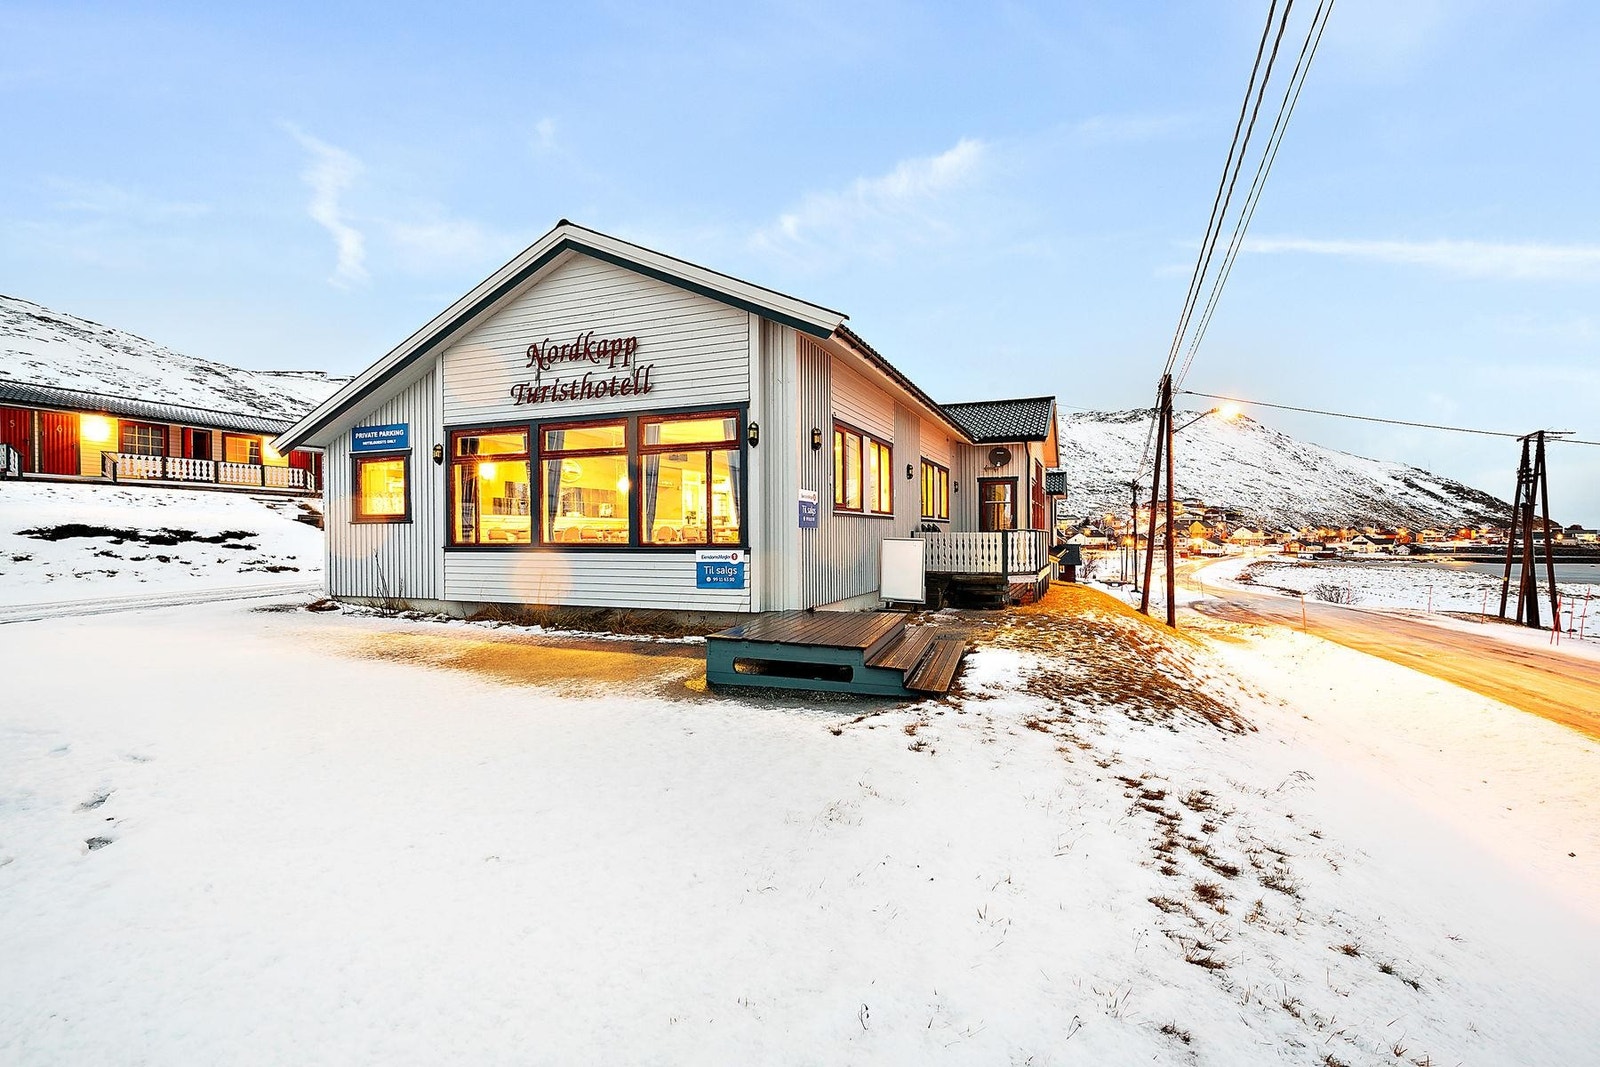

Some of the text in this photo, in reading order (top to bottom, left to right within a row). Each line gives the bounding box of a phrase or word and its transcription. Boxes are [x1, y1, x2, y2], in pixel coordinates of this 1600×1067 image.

[526, 331, 638, 370] Nordkapp
[510, 364, 654, 406] Turisthotell
[56, 424, 63, 433] 6
[704, 565, 737, 576] Til salgs
